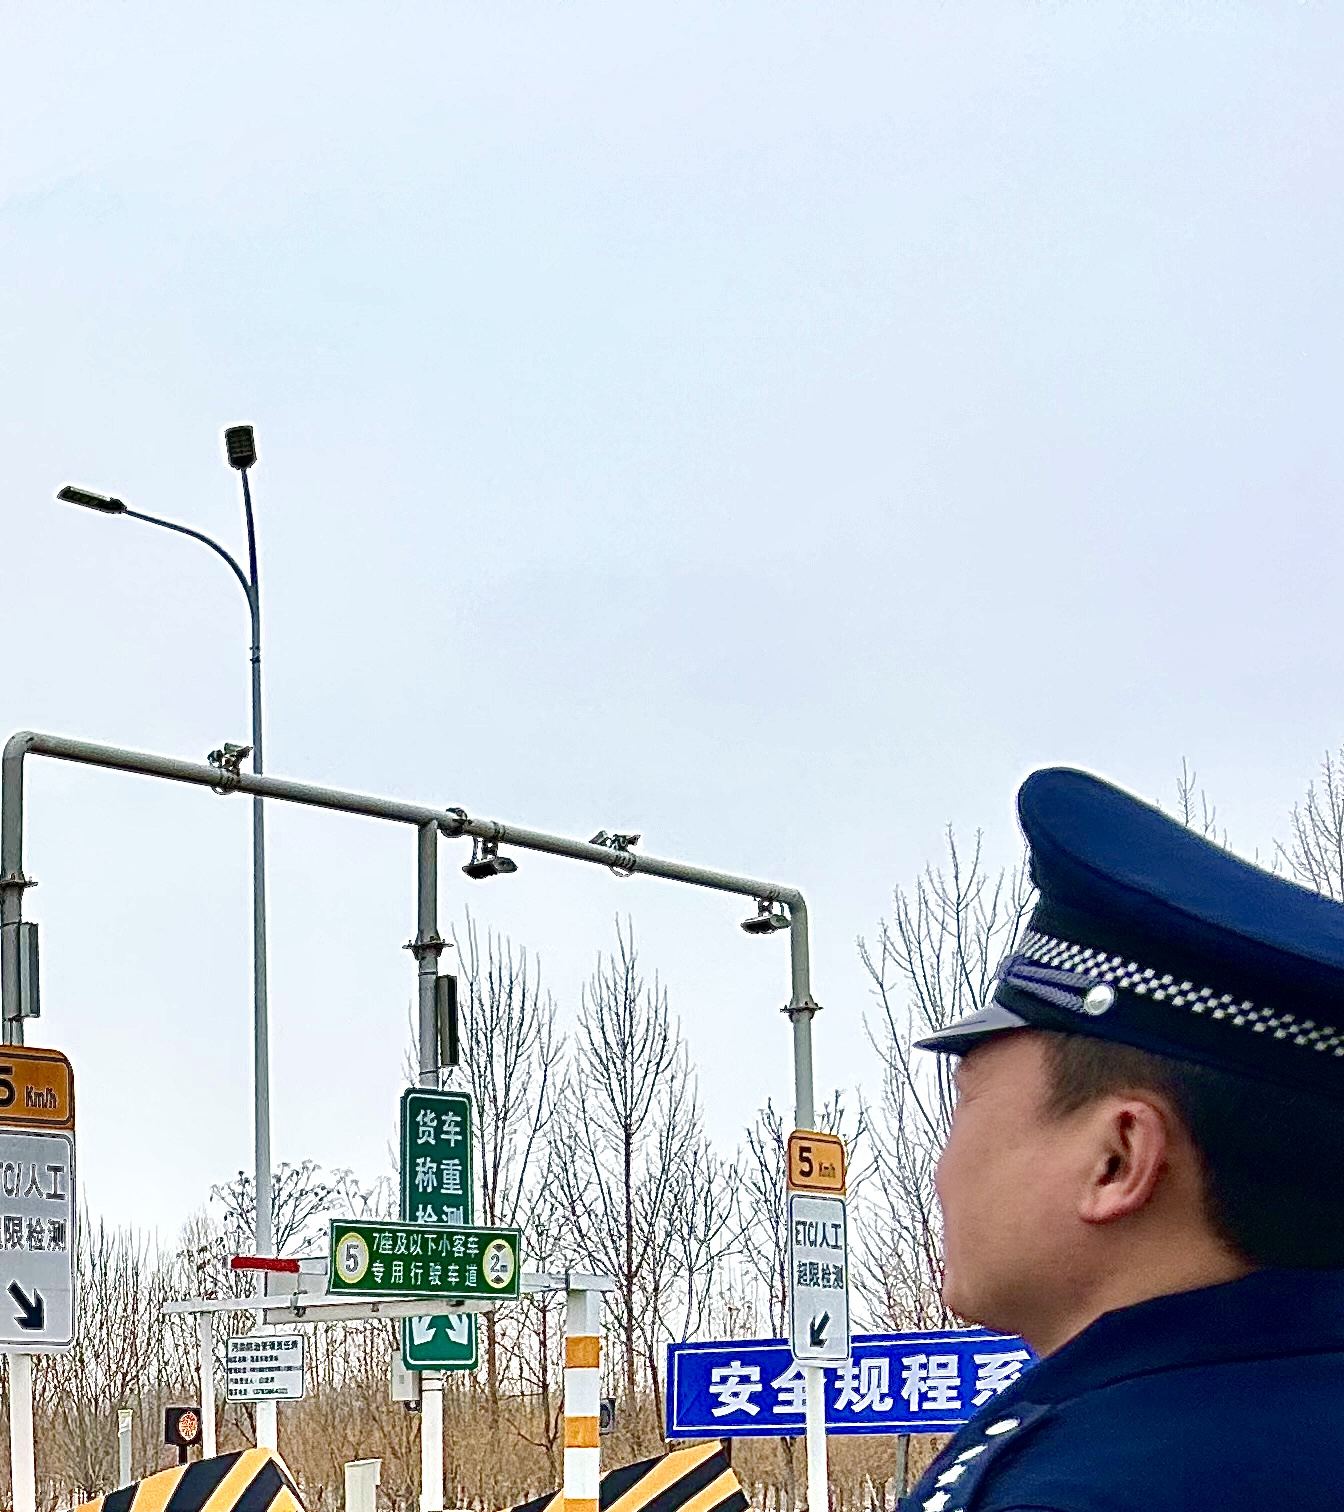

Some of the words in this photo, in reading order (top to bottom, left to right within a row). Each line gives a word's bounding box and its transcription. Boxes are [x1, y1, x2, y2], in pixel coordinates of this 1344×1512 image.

[25, 1085, 58, 1110] Km/h
[415, 1108, 463, 1148] 货车
[415, 1156, 463, 1195] 称重
[798, 1146, 814, 1178] 5
[345, 1244, 360, 1273] 5
[371, 1232, 480, 1259] 7座及以下小客车
[370, 1260, 479, 1287] 专用行驶车道
